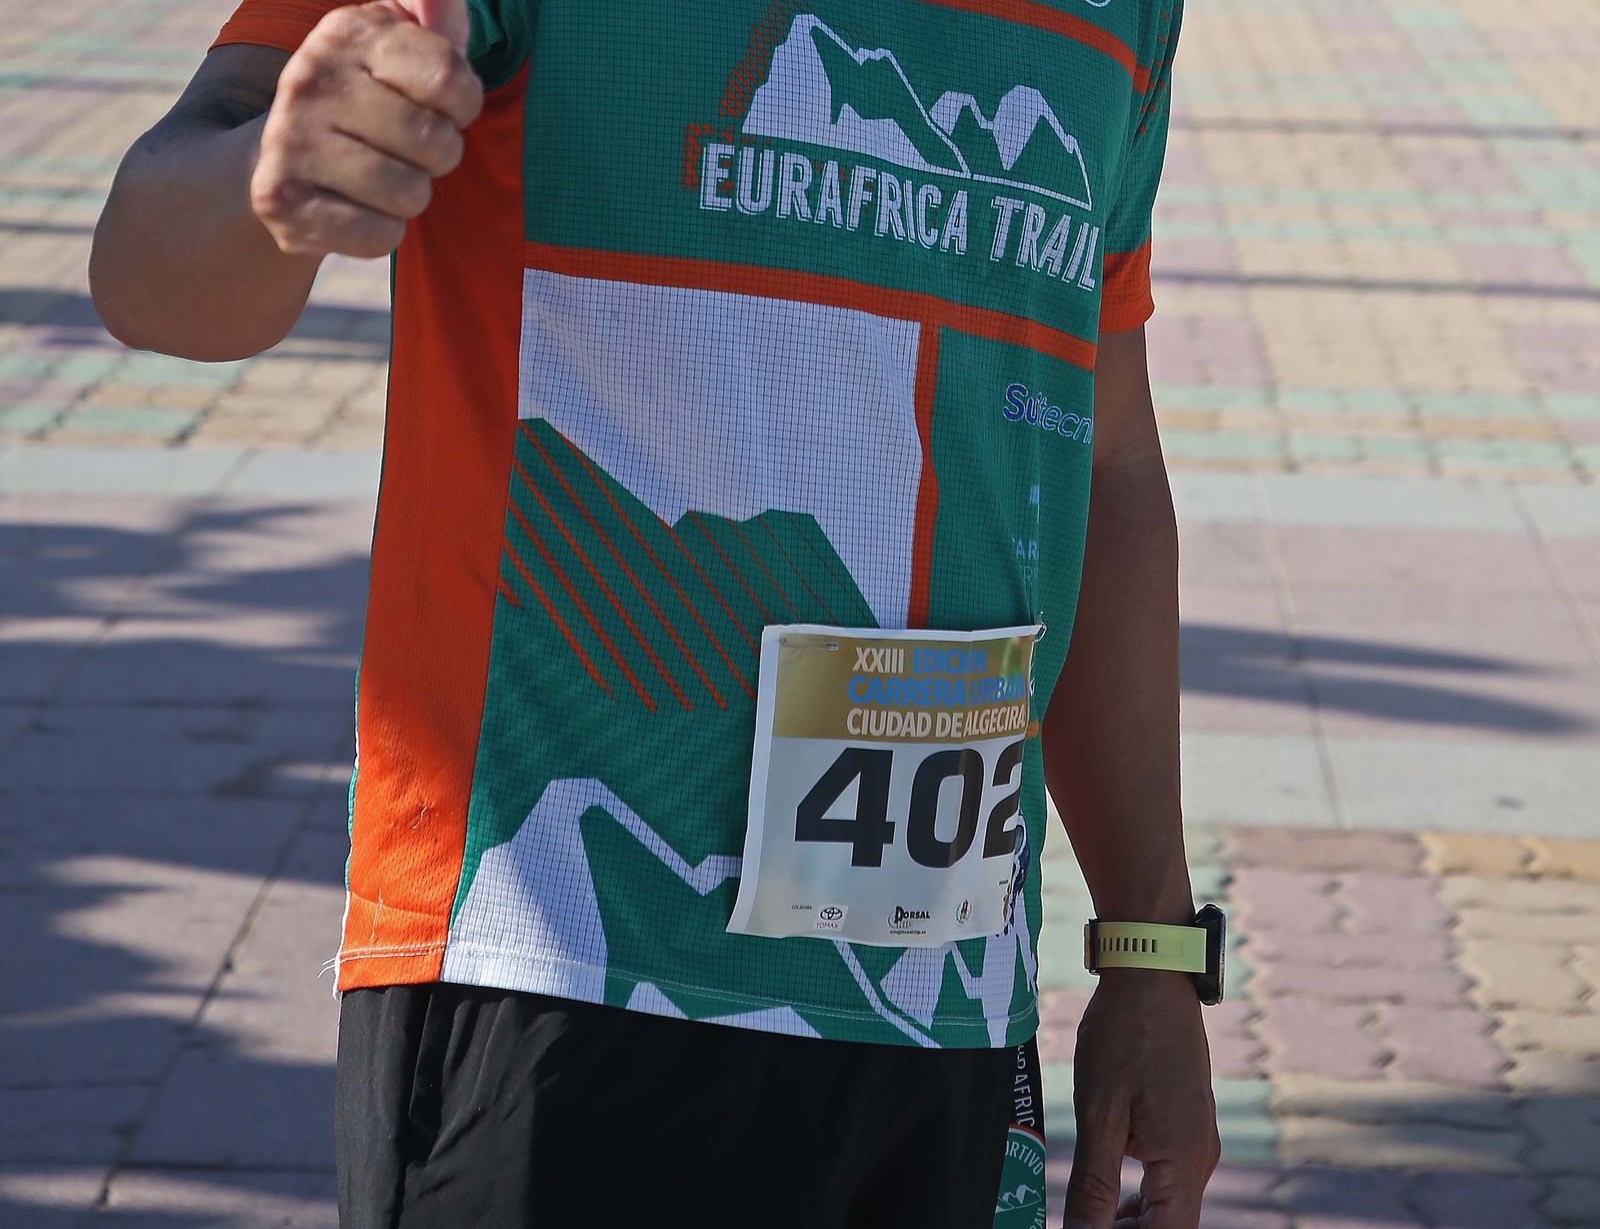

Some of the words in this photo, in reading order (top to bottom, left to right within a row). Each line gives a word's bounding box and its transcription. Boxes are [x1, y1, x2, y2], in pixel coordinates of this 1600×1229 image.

[700, 142, 967, 256] EURAFRICA
[989, 196, 1100, 291] TRAIL
[853, 646, 905, 674] XXIII
[847, 675, 968, 708] CARRERA
[846, 708, 932, 738] CIUDAD
[935, 711, 963, 738] DE
[963, 704, 1027, 738] ALGECIRA
[795, 739, 1025, 868] 402
[894, 905, 931, 924] DORSAL
